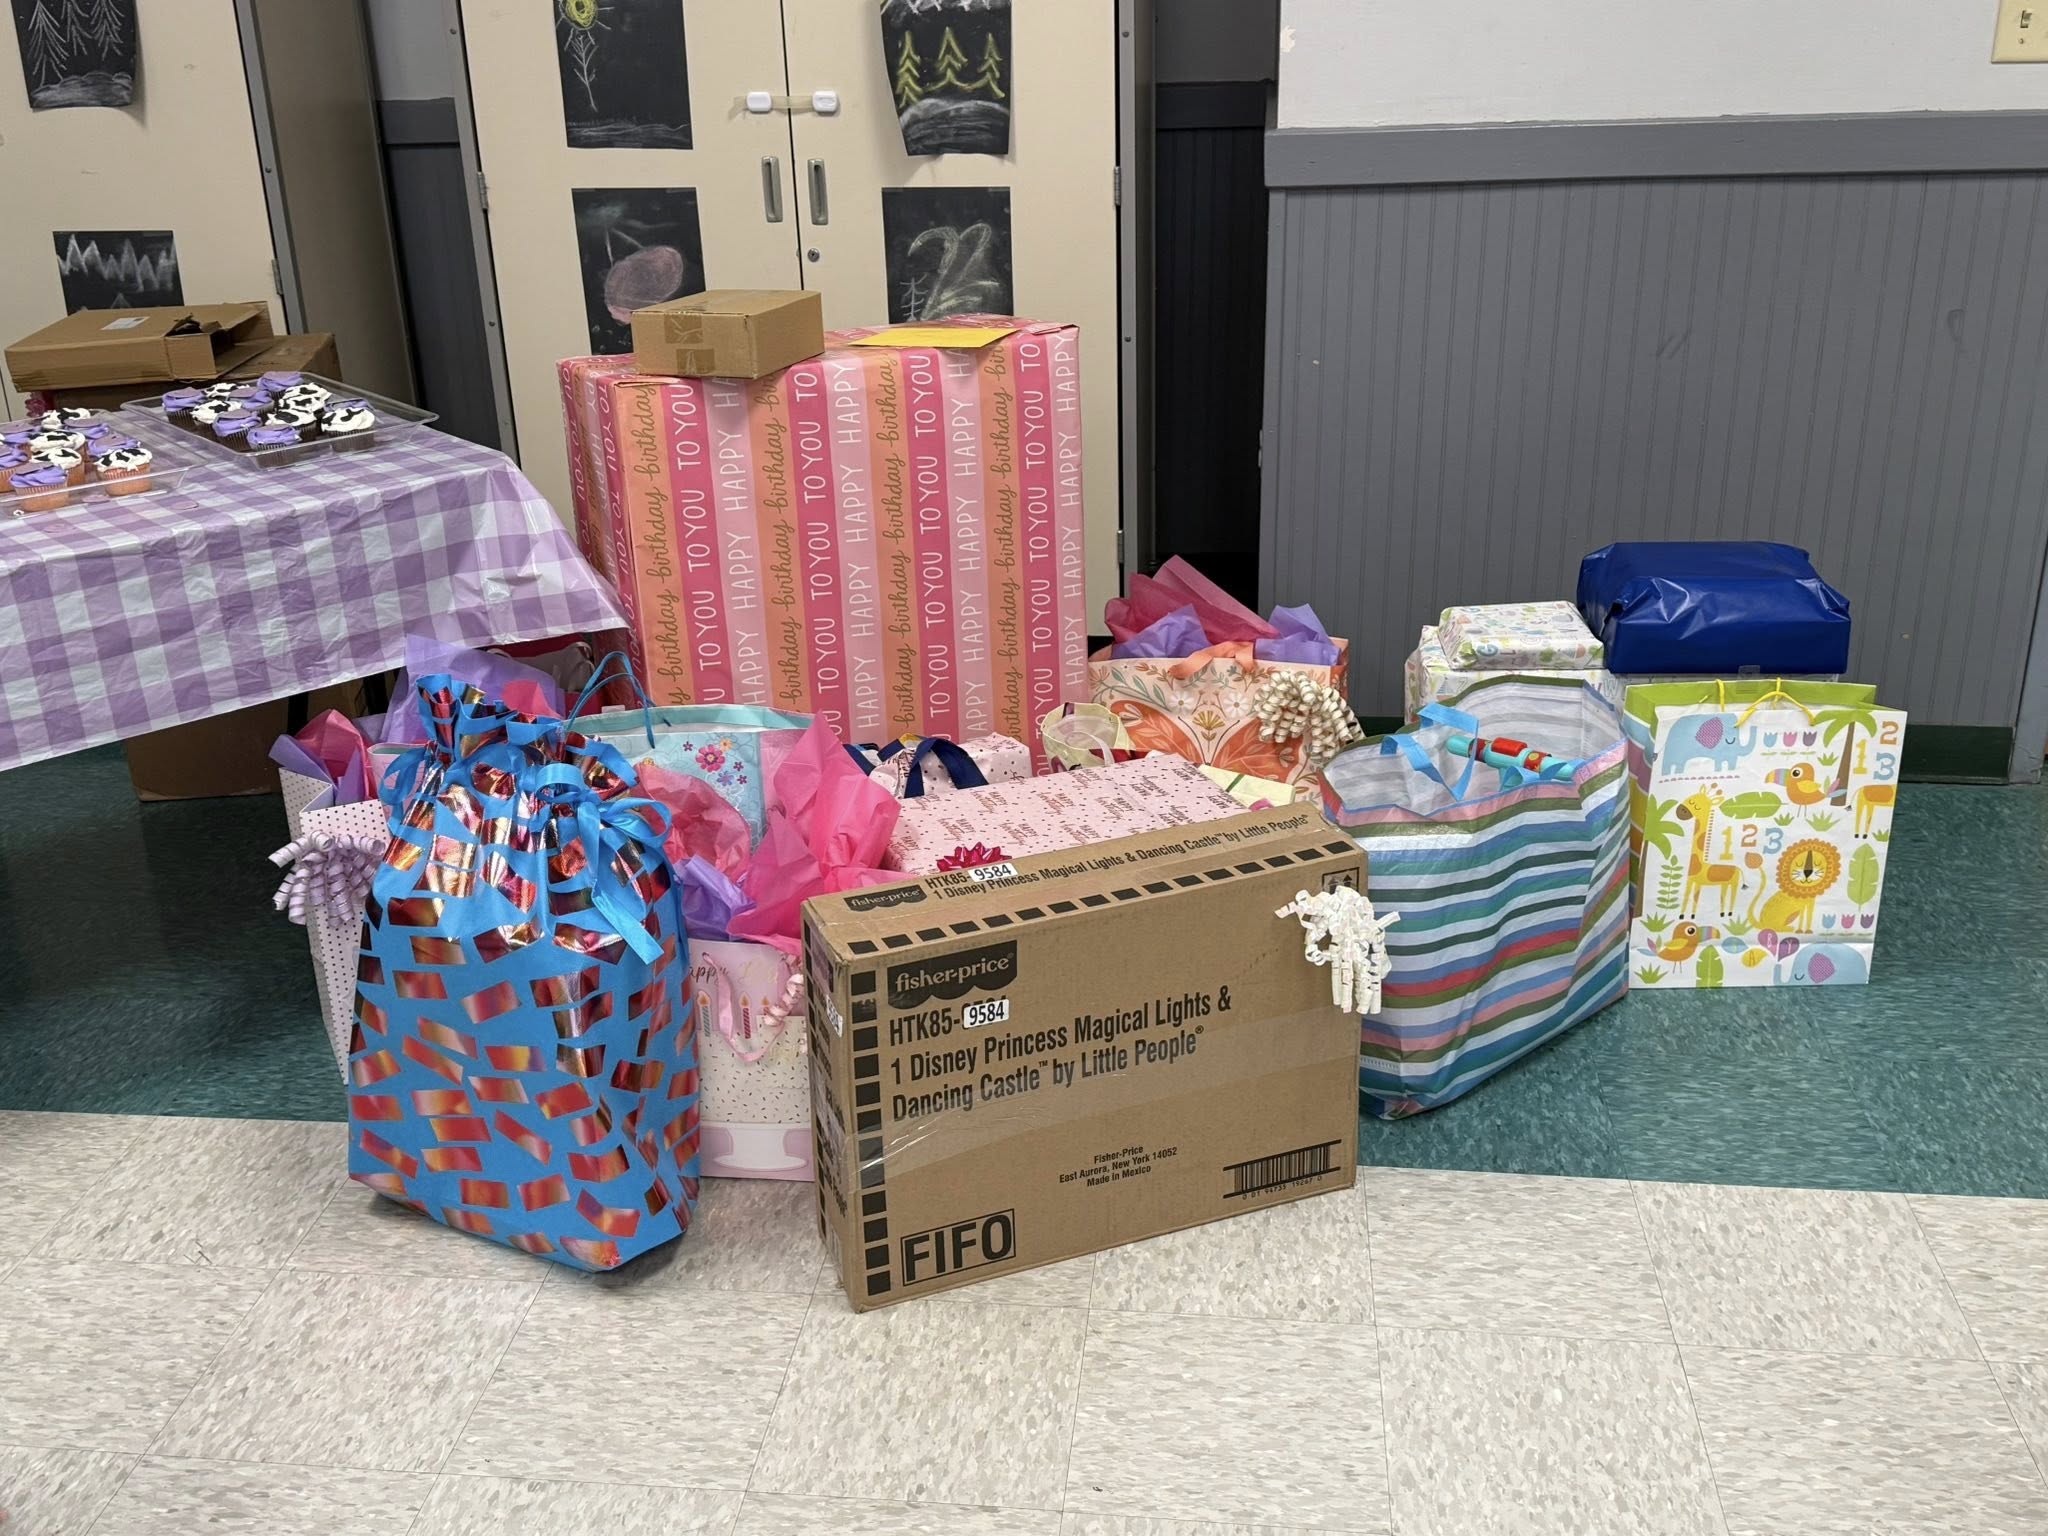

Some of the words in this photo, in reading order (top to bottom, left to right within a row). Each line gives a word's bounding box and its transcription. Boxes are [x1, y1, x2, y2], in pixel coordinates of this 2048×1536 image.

[910, 355, 935, 404] YOU
[1019, 343, 1041, 372] TO
[1054, 333, 1076, 412] HAPPY
[598, 384, 610, 414] TO
[669, 384, 699, 437] YOU
[793, 372, 818, 402] TO
[833, 363, 862, 444] HAPPY
[914, 409, 936, 438] TO
[951, 398, 977, 477] HAPPY
[989, 387, 1014, 480] birthday
[1023, 390, 1045, 438] YOU
[602, 422, 618, 471] YOU
[676, 441, 700, 470] TO
[797, 421, 824, 464] YOU
[1025, 442, 1046, 470] TO
[574, 454, 585, 500] YOU
[718, 430, 749, 512] HAPPY
[762, 418, 787, 516] birthday
[803, 475, 827, 504] TO
[916, 456, 940, 504] YOU
[1057, 432, 1080, 507] HAPPY
[610, 490, 622, 519] TO
[680, 489, 707, 537] YOU
[839, 464, 869, 544] HAPPY
[882, 453, 906, 544] birthday
[919, 507, 942, 535] TO
[1027, 487, 1048, 531] YOU
[615, 528, 629, 575] YOU
[645, 486, 672, 584] birthday
[807, 522, 832, 568] YOU
[955, 497, 981, 571] HAPPY
[994, 484, 1018, 573] birthday
[1028, 536, 1049, 562] TO
[686, 543, 711, 572] TO
[727, 531, 757, 610] HAPPY
[771, 521, 796, 611] birthday
[922, 552, 945, 599] YOU
[1061, 526, 1082, 598] HAPPY
[810, 574, 833, 600] TO
[847, 563, 874, 637] HAPPY
[888, 550, 911, 638] birthday
[1030, 579, 1051, 625] YOU
[654, 589, 684, 682] birthday
[691, 590, 718, 638] YOU
[925, 601, 946, 629] TO
[960, 590, 985, 663] HAPPY
[997, 577, 1021, 664] birthday
[698, 643, 722, 671] TO
[778, 616, 802, 704] birthday
[814, 617, 838, 664] YOU
[1032, 628, 1052, 652] TO
[1064, 616, 1084, 686] HAPPY
[735, 629, 765, 706] HAPPY
[817, 667, 839, 694] TO
[892, 643, 917, 729] birthday
[927, 645, 951, 688] YOU
[1033, 668, 1054, 711] YOU
[854, 656, 880, 729] HAPPY
[929, 692, 951, 717] TO
[964, 681, 988, 732] APPY
[1852, 739, 1867, 774] 1
[1880, 721, 1899, 744] 2
[1873, 752, 1896, 780] 3
[933, 890, 942, 900] 1
[944, 883, 986, 899] Disney
[988, 874, 1040, 890] Princess
[1039, 861, 1088, 881] Magical
[1089, 853, 1125, 873] Lights
[1127, 850, 1138, 863] &
[1138, 842, 1186, 861] Dancing
[1222, 831, 1240, 846] by
[1241, 822, 1270, 839] Little
[1720, 826, 1734, 860] 1
[1740, 824, 1759, 847] 2
[1762, 827, 1784, 854] 3
[974, 864, 1012, 880] 9584
[891, 1058, 901, 1085] 1
[911, 1047, 978, 1081] Disney
[984, 1026, 1068, 1064] Princess
[1074, 1002, 1148, 1044] Magical
[1155, 992, 1211, 1028] Lights
[1218, 985, 1231, 1011] &
[969, 1002, 1005, 1026] 9584
[892, 1084, 973, 1122] Dancing
[1053, 1058, 1075, 1088] by
[1082, 1045, 1128, 1078] Little
[1059, 1171, 1077, 1183] East
[1080, 1166, 1110, 1178] Aurora,
[1112, 1160, 1130, 1170] New
[1132, 1154, 1150, 1165] York
[1152, 1147, 1178, 1160] 14052
[1087, 1175, 1109, 1187] Made
[1112, 1172, 1119, 1181] in
[1122, 1165, 1151, 1178] Mexico
[1094, 1146, 1143, 1164] Fisher-Price
[905, 1215, 1011, 1282] FIFO
